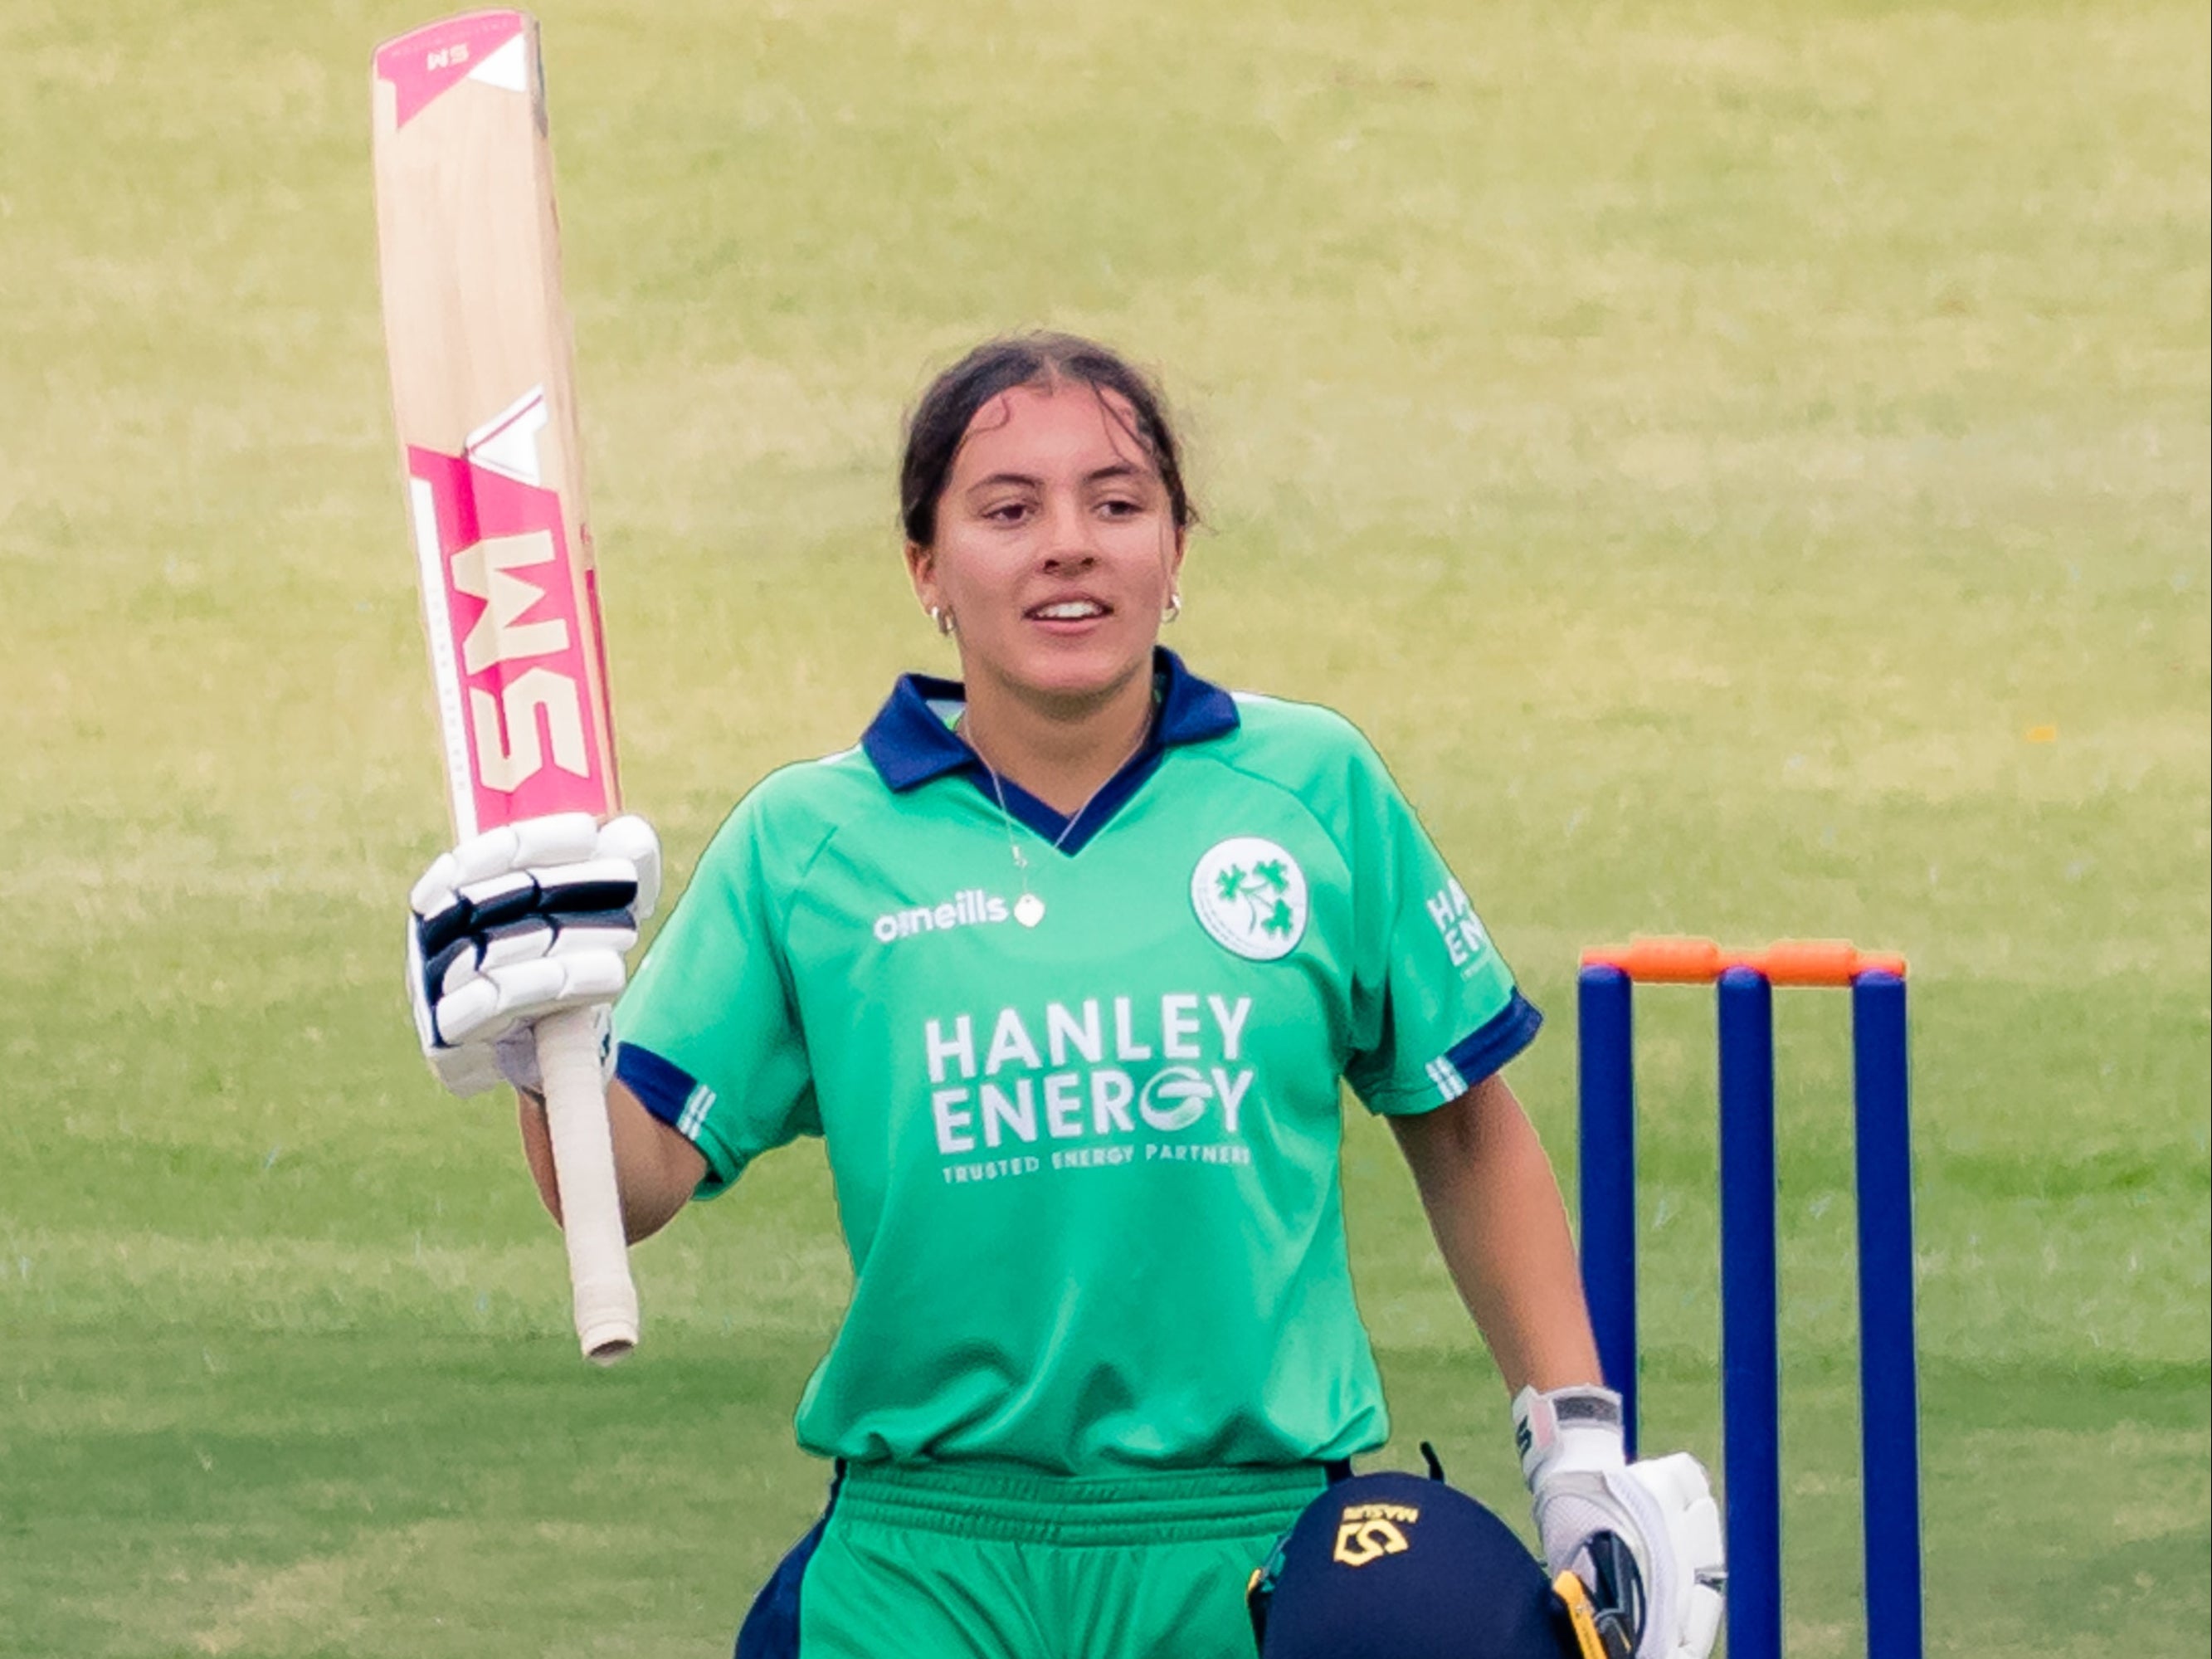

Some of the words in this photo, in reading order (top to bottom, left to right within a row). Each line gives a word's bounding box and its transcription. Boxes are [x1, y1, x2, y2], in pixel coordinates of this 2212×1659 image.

[450, 529, 589, 793] SM
[926, 993, 1251, 1082] HANLEY
[932, 1066, 1253, 1154] ENERGY
[943, 1157, 1039, 1183] TRUSTED
[1051, 1146, 1133, 1170] ENERGY
